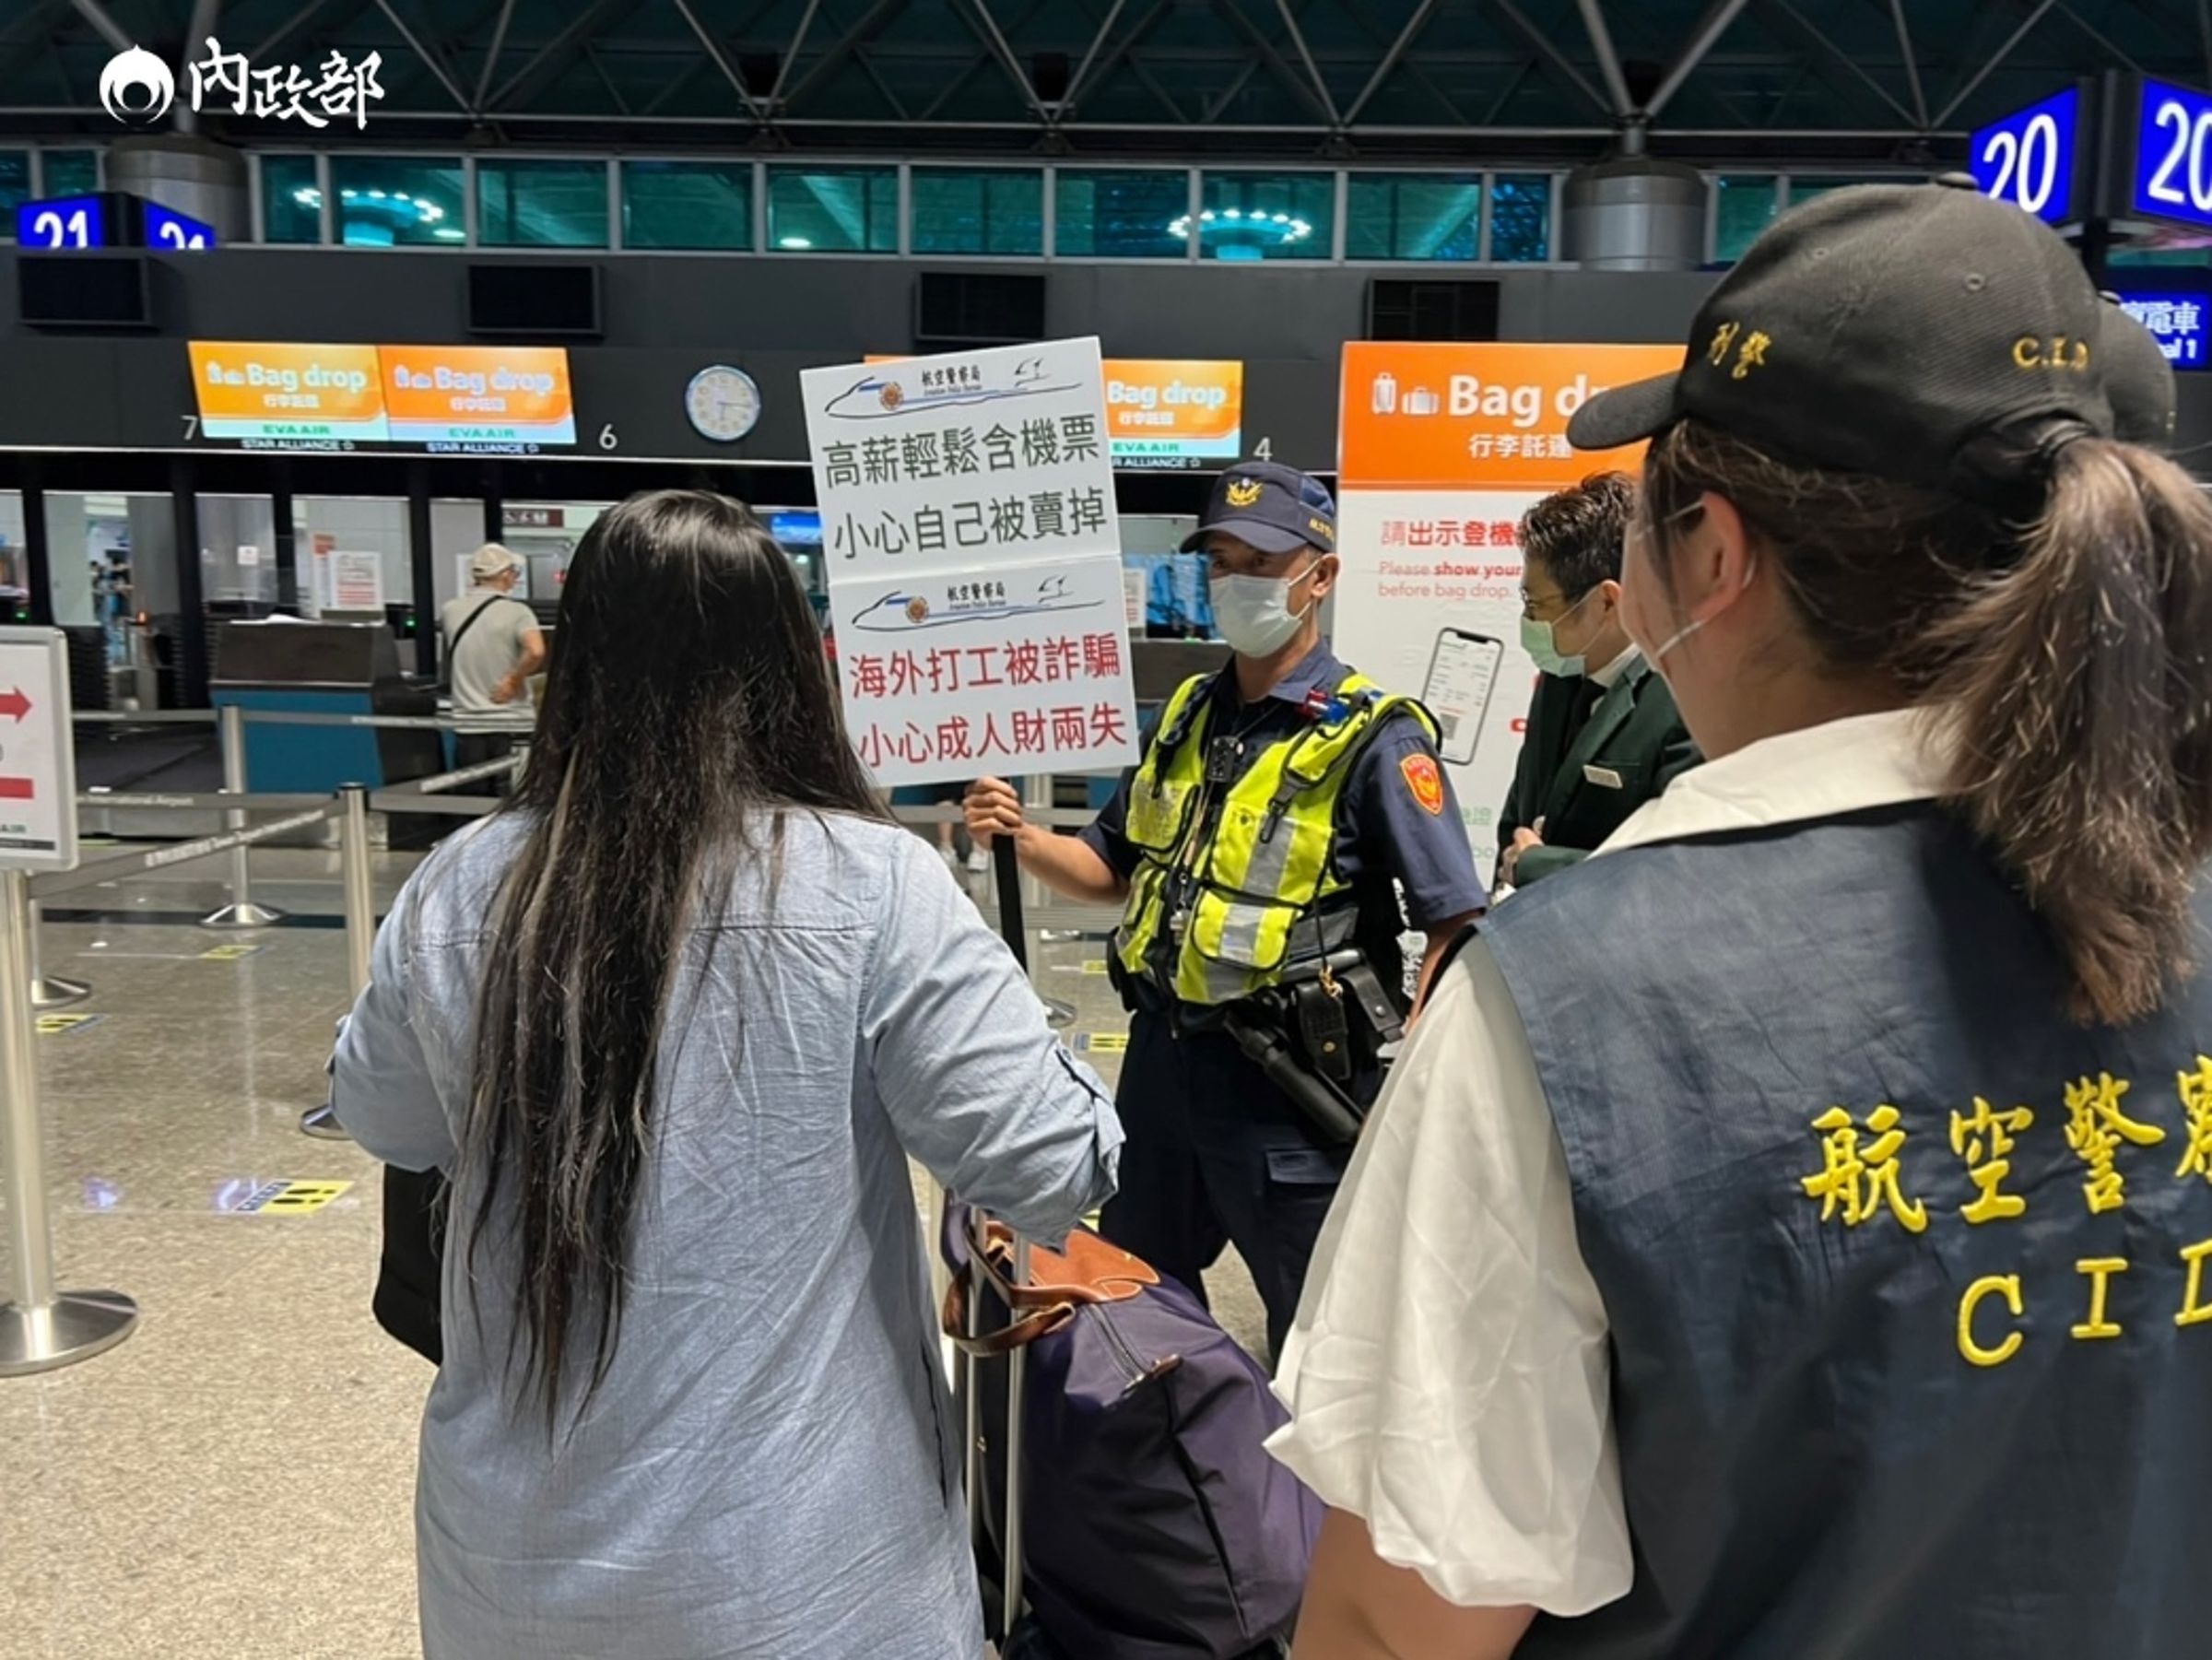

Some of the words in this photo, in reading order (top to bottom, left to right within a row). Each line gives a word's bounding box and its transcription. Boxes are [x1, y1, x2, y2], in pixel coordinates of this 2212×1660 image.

[1983, 113, 2058, 213] 20
[2147, 100, 2212, 211] 20
[246, 362, 299, 392] Bag
[304, 363, 367, 394] drop
[434, 366, 486, 395] Bag
[490, 367, 555, 396] drop
[1107, 381, 1157, 409] Bag
[1162, 380, 1227, 410] drop
[1449, 374, 1542, 428] Bag
[182, 416, 197, 440] 7
[599, 424, 618, 450] 6
[241, 440, 276, 449] STAR
[278, 440, 340, 451] ALLIANCE
[427, 441, 460, 453] STAR
[463, 442, 524, 453] ALLIANCE
[822, 413, 1100, 489] 高薪輕鬆含機票
[1253, 437, 1273, 462] 4
[1469, 434, 1572, 459] 行李託運
[1123, 456, 1186, 467] ALLIANCE
[834, 486, 1107, 559] 小心自己被賣掉
[1380, 561, 1430, 576] Please
[1434, 561, 1478, 576] show
[1484, 564, 1522, 580] your
[1379, 583, 1430, 597] before
[1435, 583, 1466, 601] bag
[849, 632, 1121, 700] 海外打工被詐騙
[859, 701, 1127, 768] 小心成人財兩失
